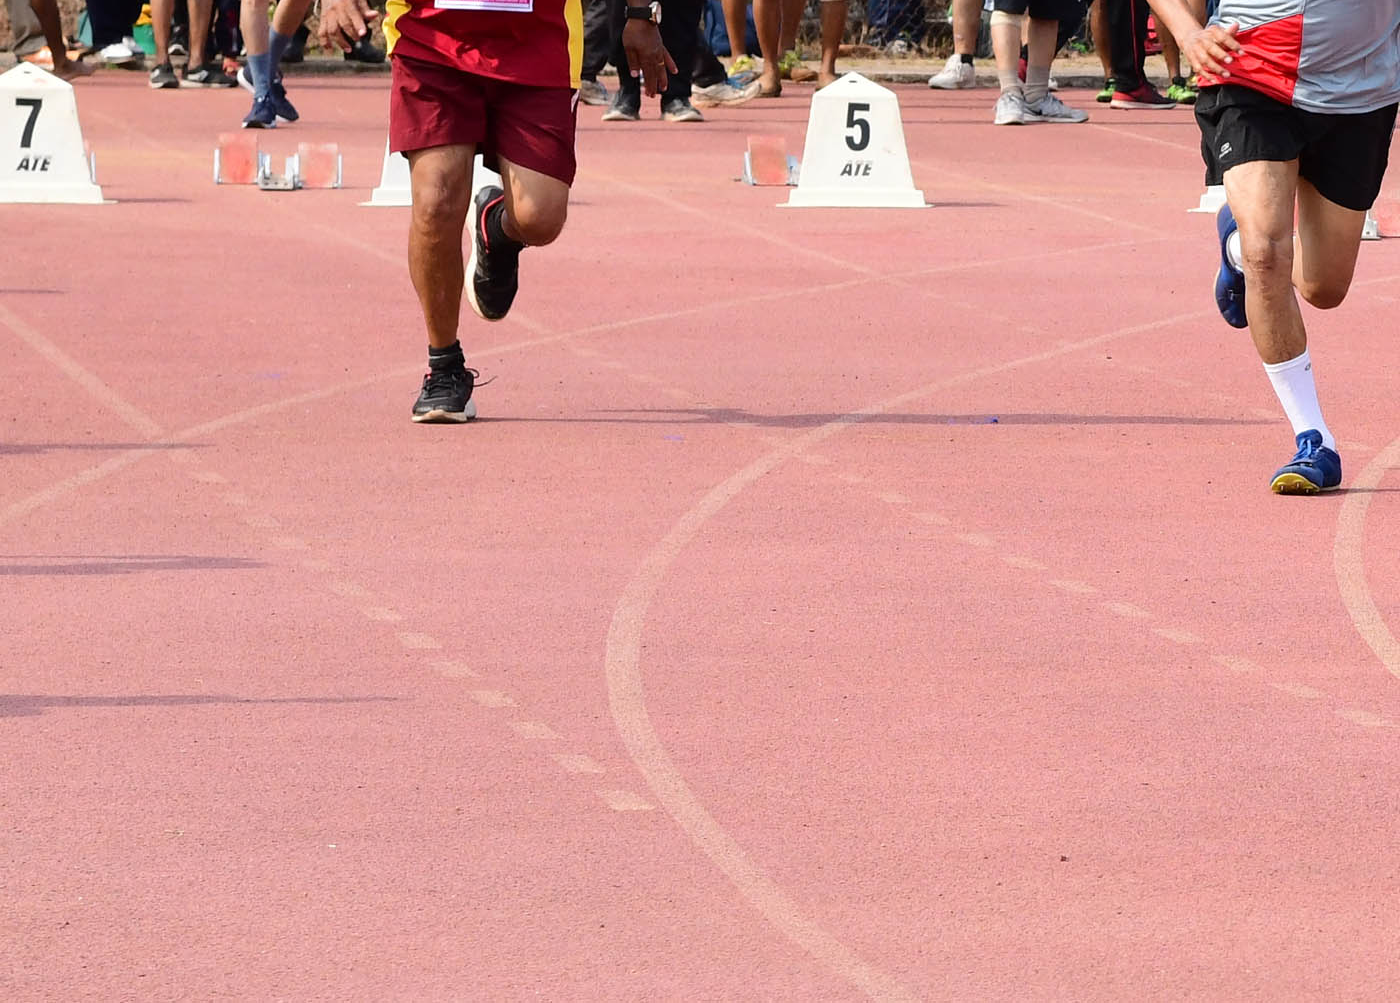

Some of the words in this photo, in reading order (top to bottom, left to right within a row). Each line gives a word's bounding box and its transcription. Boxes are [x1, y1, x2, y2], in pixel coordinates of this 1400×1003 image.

[15, 98, 43, 148] 7
[845, 102, 870, 151] 5
[16, 156, 50, 171] ATE
[840, 162, 872, 176] ATE
